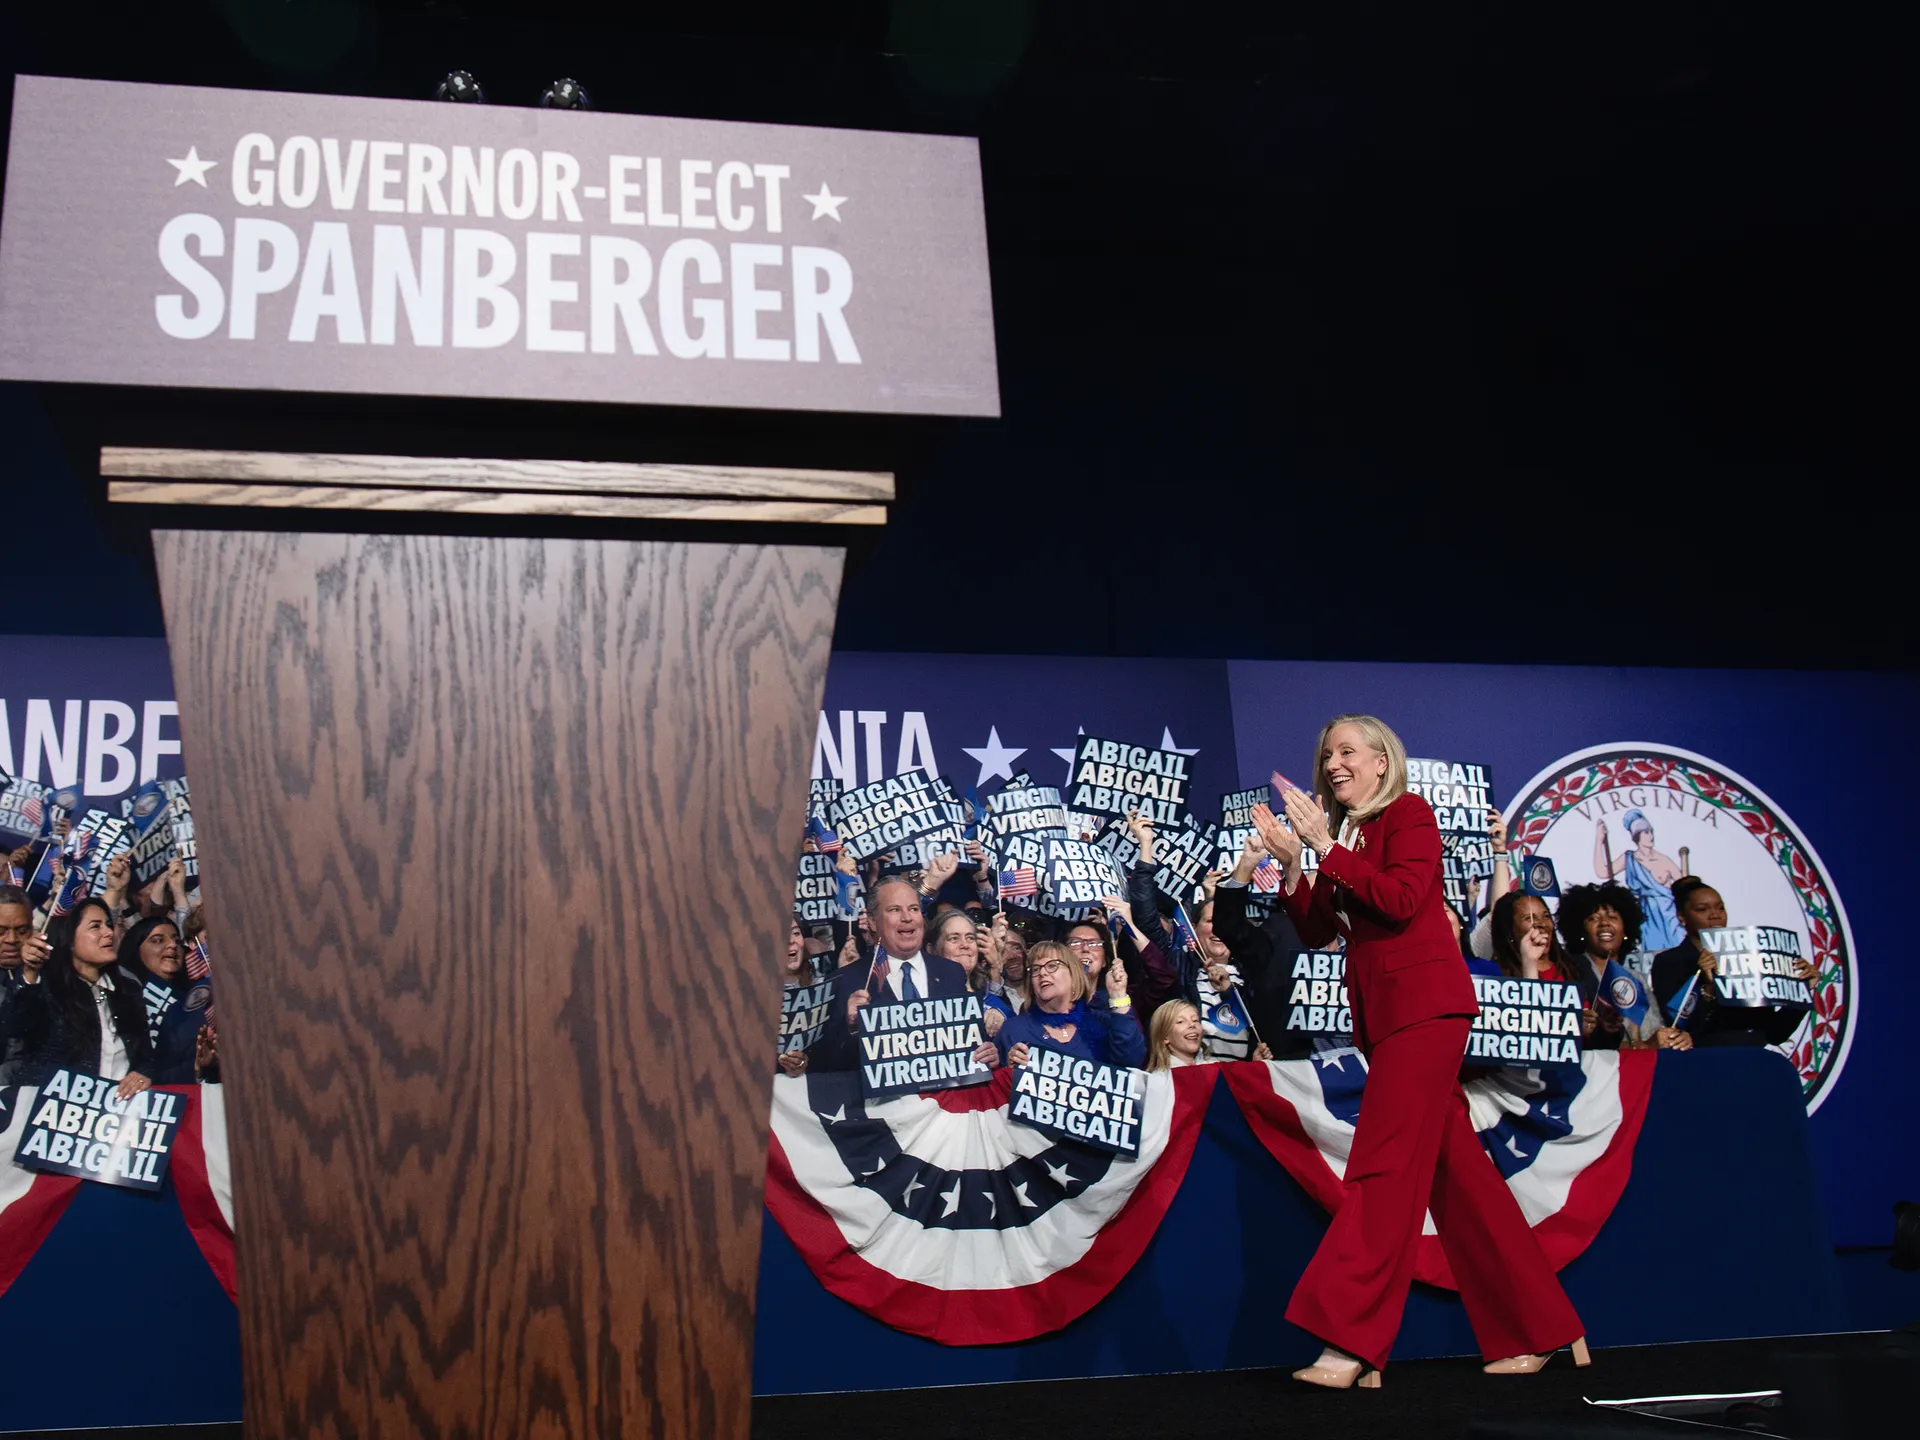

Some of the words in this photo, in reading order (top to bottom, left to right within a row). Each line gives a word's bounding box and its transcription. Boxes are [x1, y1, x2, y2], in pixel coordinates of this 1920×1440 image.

[232, 133, 790, 233] GOVERNOR-ELECT
[154, 213, 862, 365] SPANBERGER
[1080, 738, 1188, 780] ABIGAIL
[1406, 760, 1490, 788] BIGAIL
[829, 771, 929, 826] ABIGAIL
[1076, 761, 1184, 804] ABIGAIL
[836, 789, 938, 843] ABIGAIL
[1072, 784, 1181, 827] ABIGAIL
[1433, 807, 1492, 832] GAIL
[1574, 788, 1719, 829] VIRGINIA
[843, 807, 946, 859] ABIGAIL
[1702, 928, 1800, 955] VIRGINIA
[1473, 979, 1582, 1009] IRGINIA
[1714, 976, 1813, 1003] VIRGINIA
[860, 996, 983, 1032] VIRGINIA
[1286, 1006, 1354, 1032] ABIG
[1472, 1005, 1581, 1036] IRGINIA
[862, 1023, 984, 1060] VIRGINIA
[1464, 1031, 1580, 1063] IRGINIA
[864, 1051, 989, 1088] VIRGINIA
[1018, 1046, 1141, 1100] ABIGAIL
[42, 1069, 177, 1124] ABIGAIL
[1015, 1071, 1138, 1125] ABIGAIL
[31, 1099, 168, 1153] ABIGAIL
[1012, 1094, 1136, 1150] ABIGAIL
[21, 1128, 159, 1183] ABIGAIL
